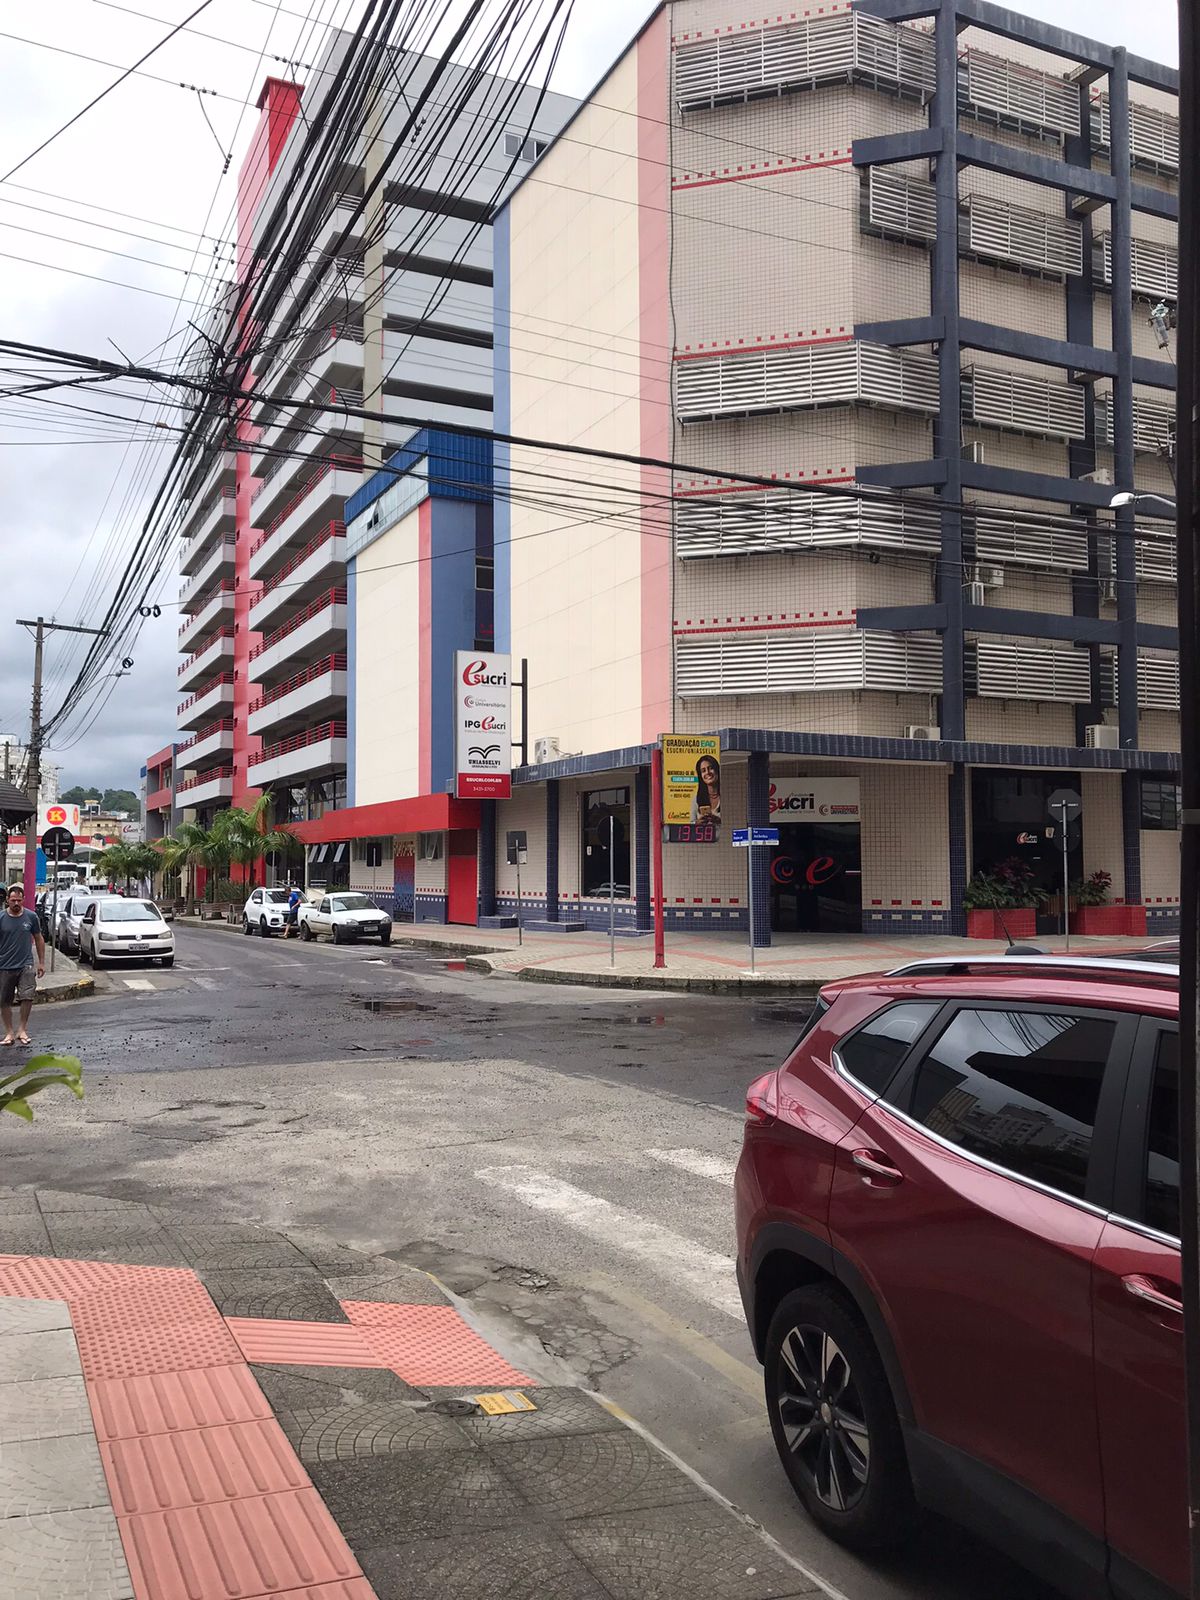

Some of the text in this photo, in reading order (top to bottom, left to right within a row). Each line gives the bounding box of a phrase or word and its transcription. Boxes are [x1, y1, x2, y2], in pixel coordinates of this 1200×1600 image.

[463, 660, 507, 686] esucri
[464, 720, 481, 729] IPG
[666, 739, 700, 748] GRADUAÇÃO
[48, 810, 64, 821] K
[680, 826, 713, 842] 13 58
